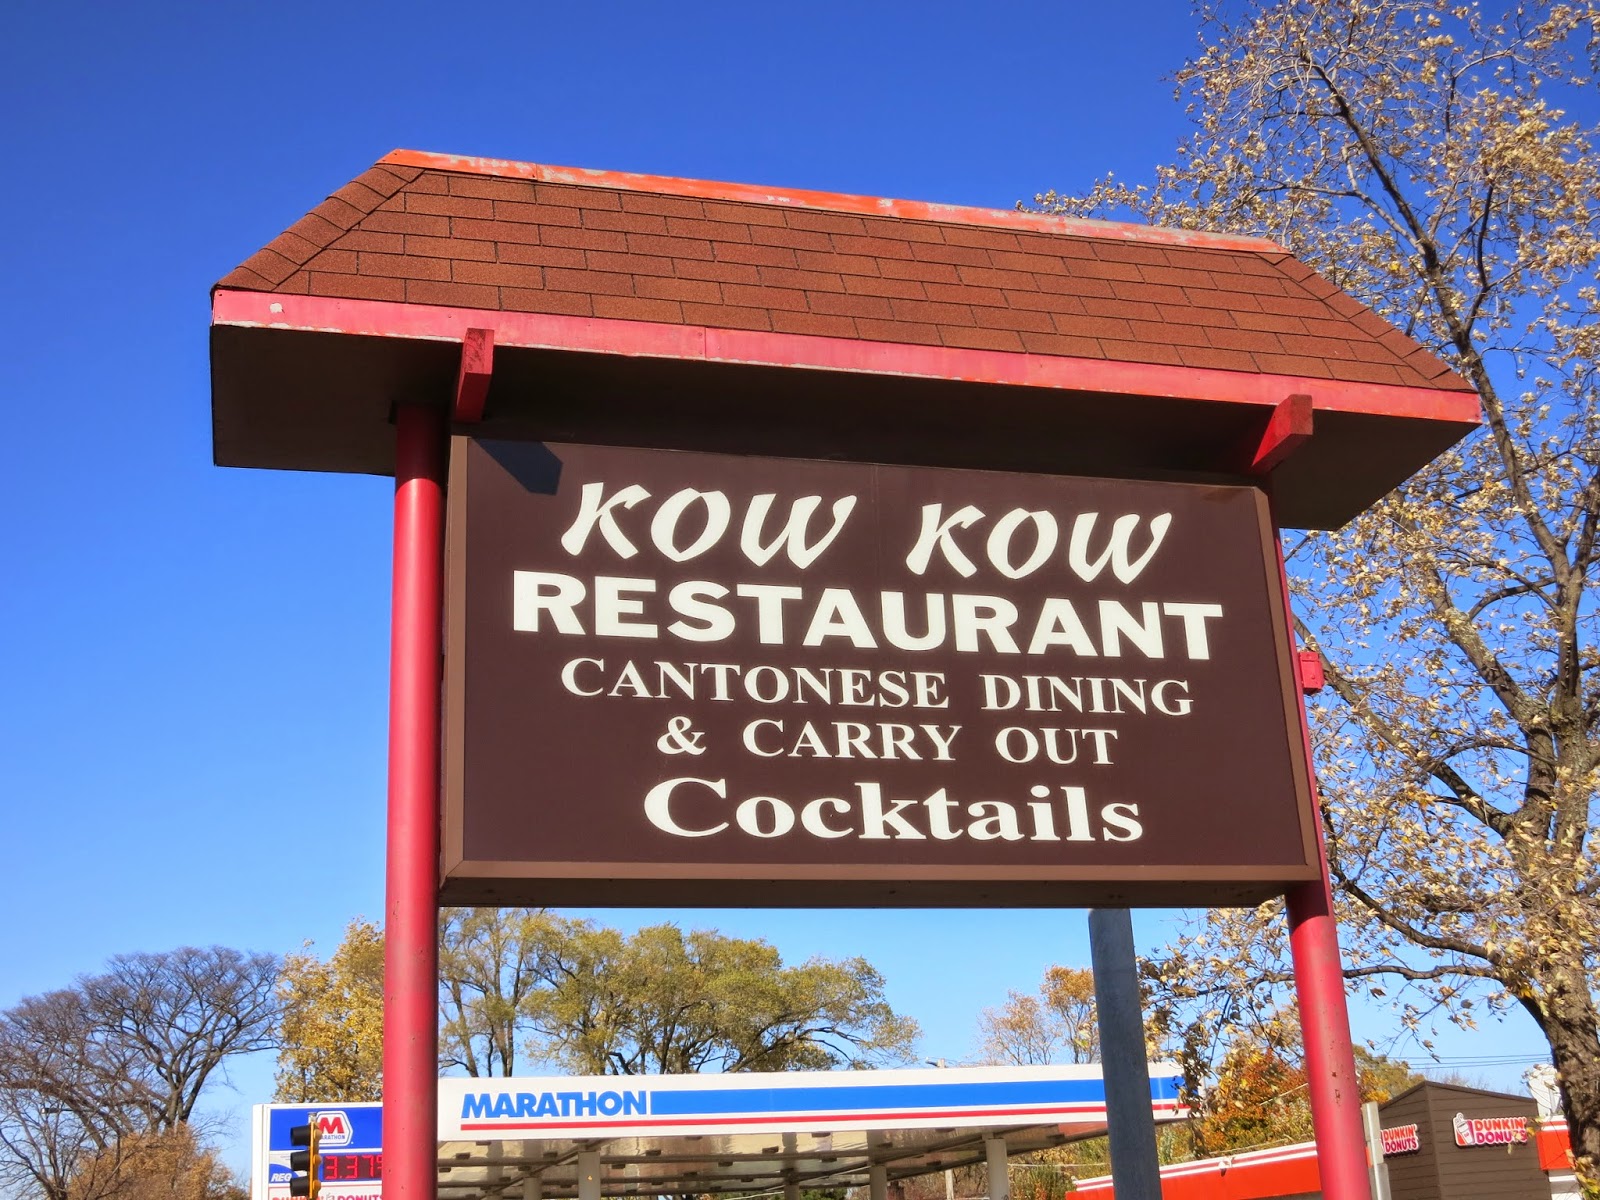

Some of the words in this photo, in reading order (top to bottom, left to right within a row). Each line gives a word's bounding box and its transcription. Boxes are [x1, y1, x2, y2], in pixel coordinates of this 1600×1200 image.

[561, 482, 857, 569] KOW
[906, 503, 1172, 584] KOW
[514, 570, 1223, 660] RESTAURANT
[562, 658, 948, 708] CANTONESE
[979, 675, 1193, 715] DINING
[657, 716, 706, 755] &
[743, 719, 962, 760] CARRY
[995, 727, 1118, 764] OUT
[644, 777, 1142, 841] Cocktails
[461, 1090, 646, 1118] MARATHON
[319, 1117, 344, 1134] M
[1383, 1124, 1417, 1141] DUNKIN'
[1474, 1117, 1527, 1131] DUNKIN'
[1385, 1137, 1418, 1152] DONUTS
